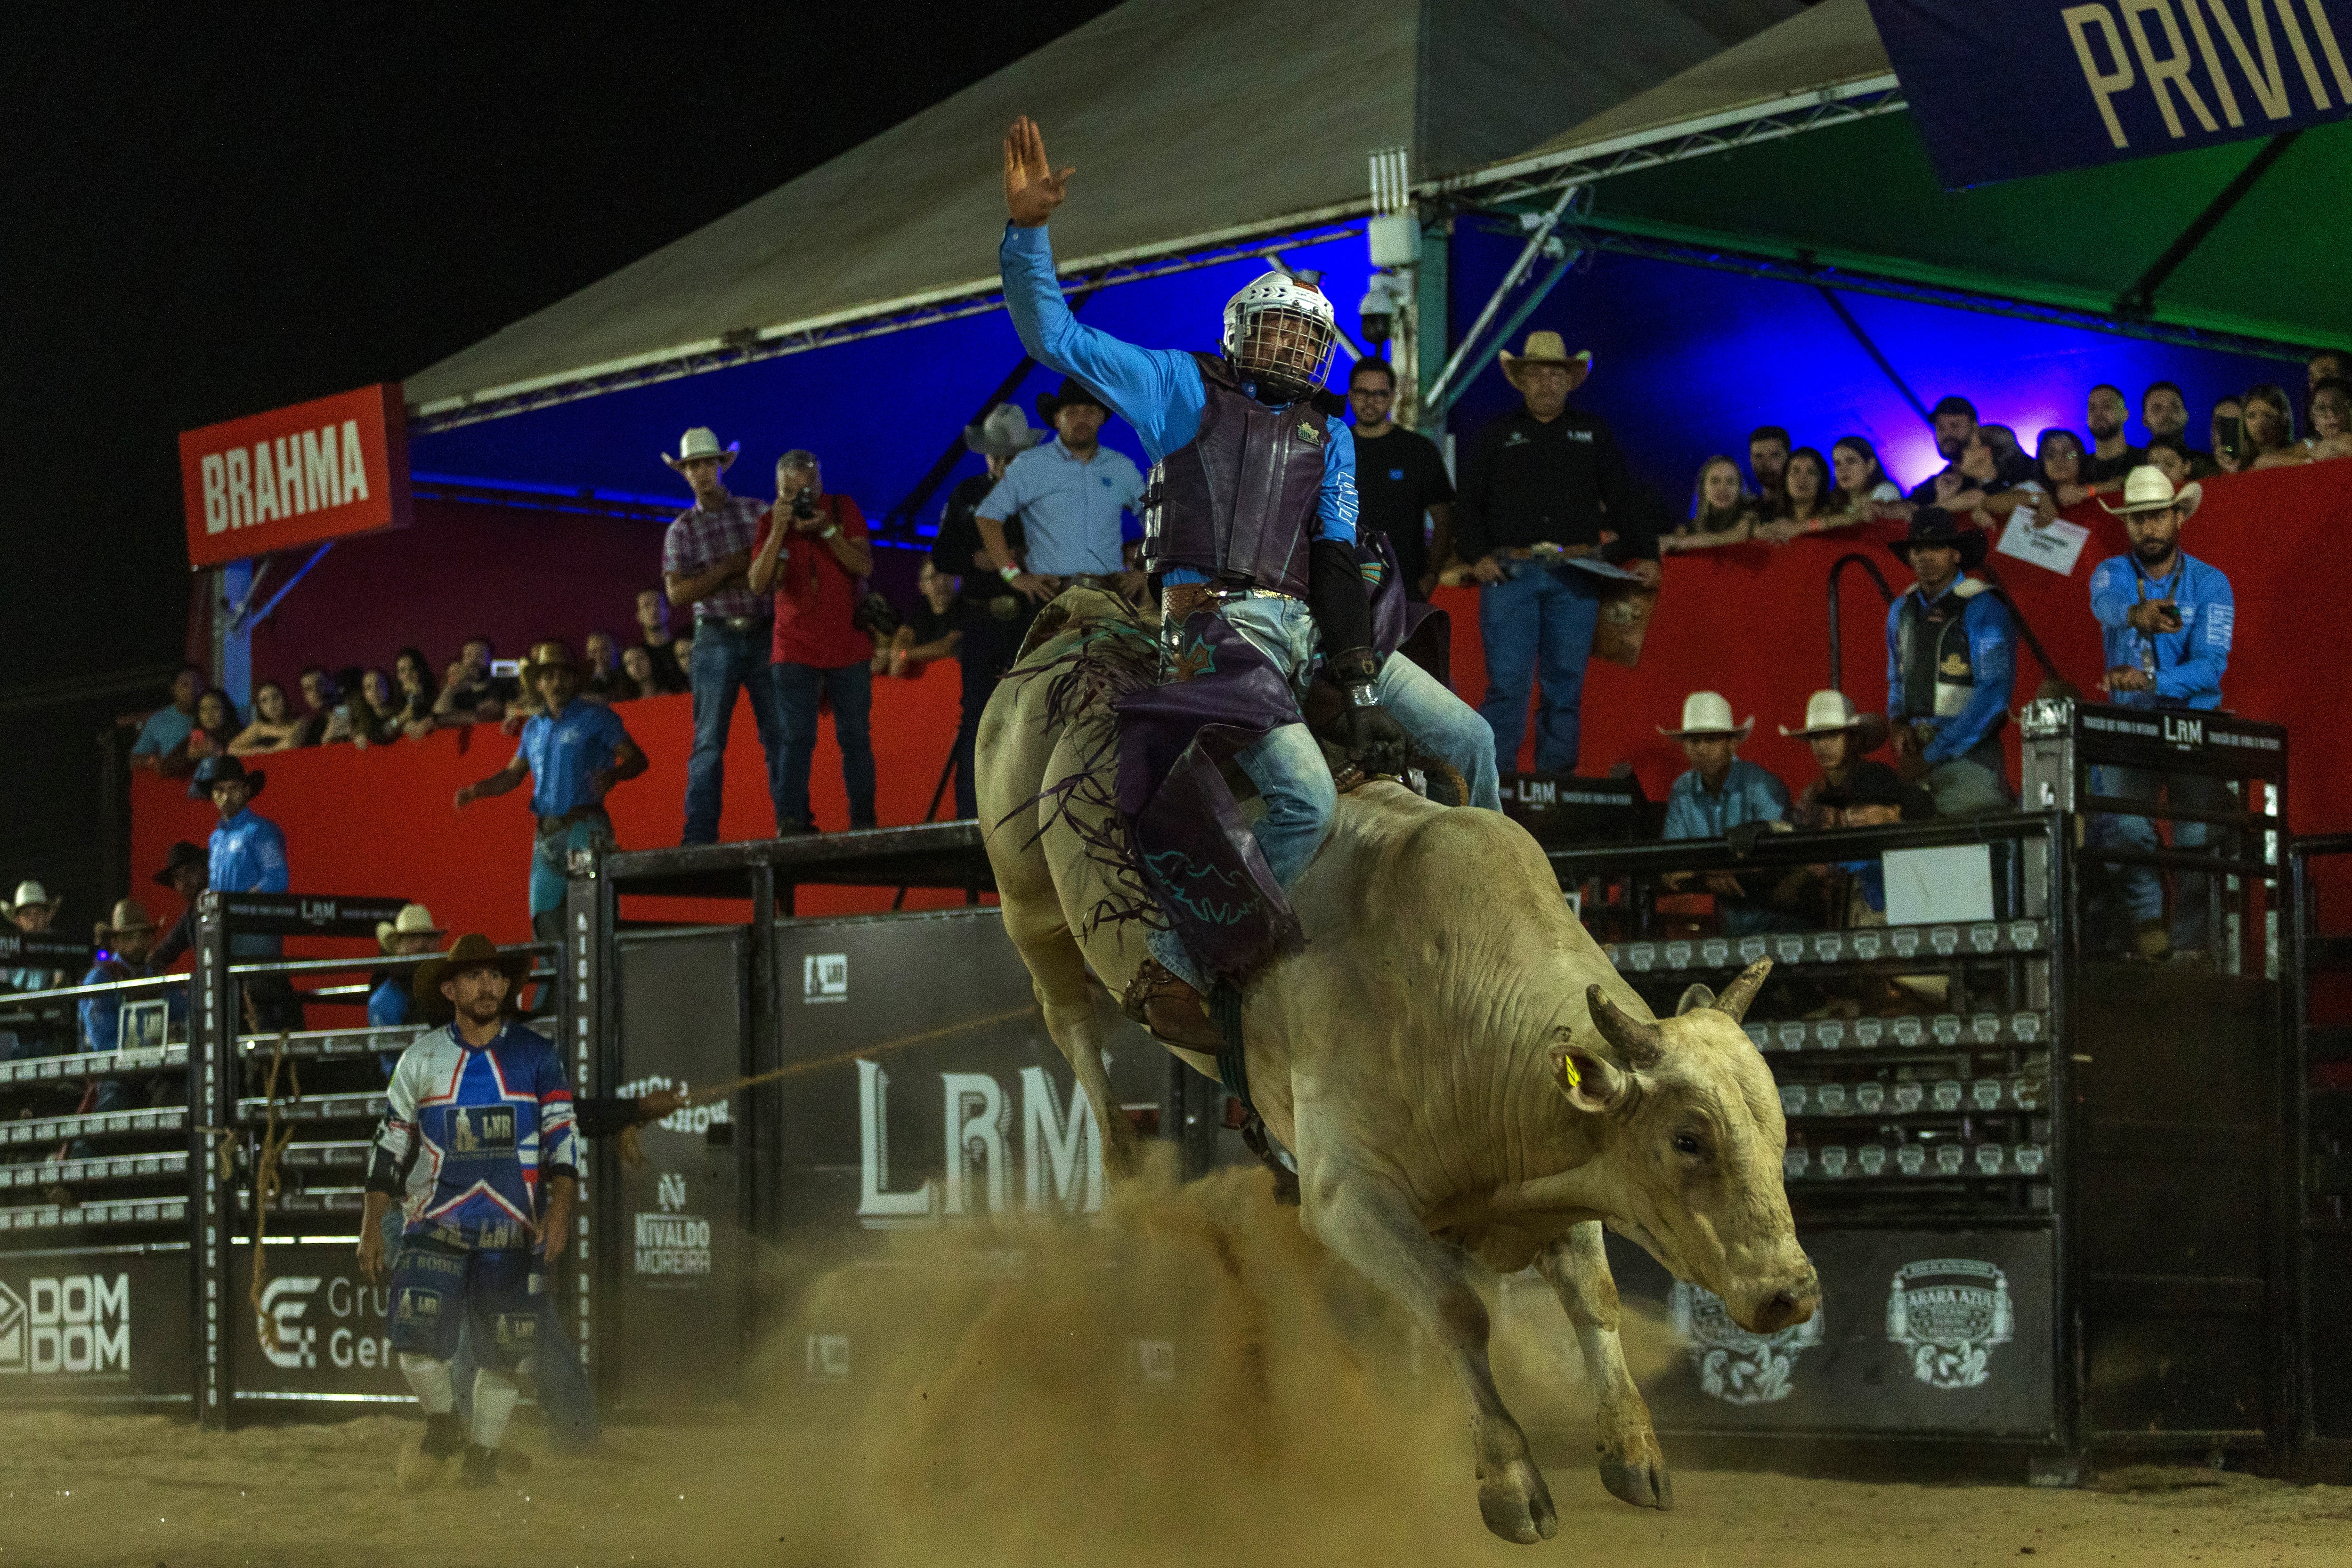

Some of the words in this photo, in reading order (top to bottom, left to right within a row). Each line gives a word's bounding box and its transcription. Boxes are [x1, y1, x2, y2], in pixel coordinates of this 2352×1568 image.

[201, 419, 370, 535] BRAHMA
[2164, 716, 2203, 744] LRM
[1517, 779, 1556, 804] LRM
[301, 900, 336, 920] LRM
[578, 1014, 590, 1202] NACINAL
[854, 1058, 1112, 1217] LRM
[634, 1212, 711, 1248] NIVALDO
[30, 1272, 130, 1324] DOM
[327, 1276, 392, 1318] Gru
[31, 1324, 130, 1373] DOM
[329, 1326, 392, 1369] Ger
